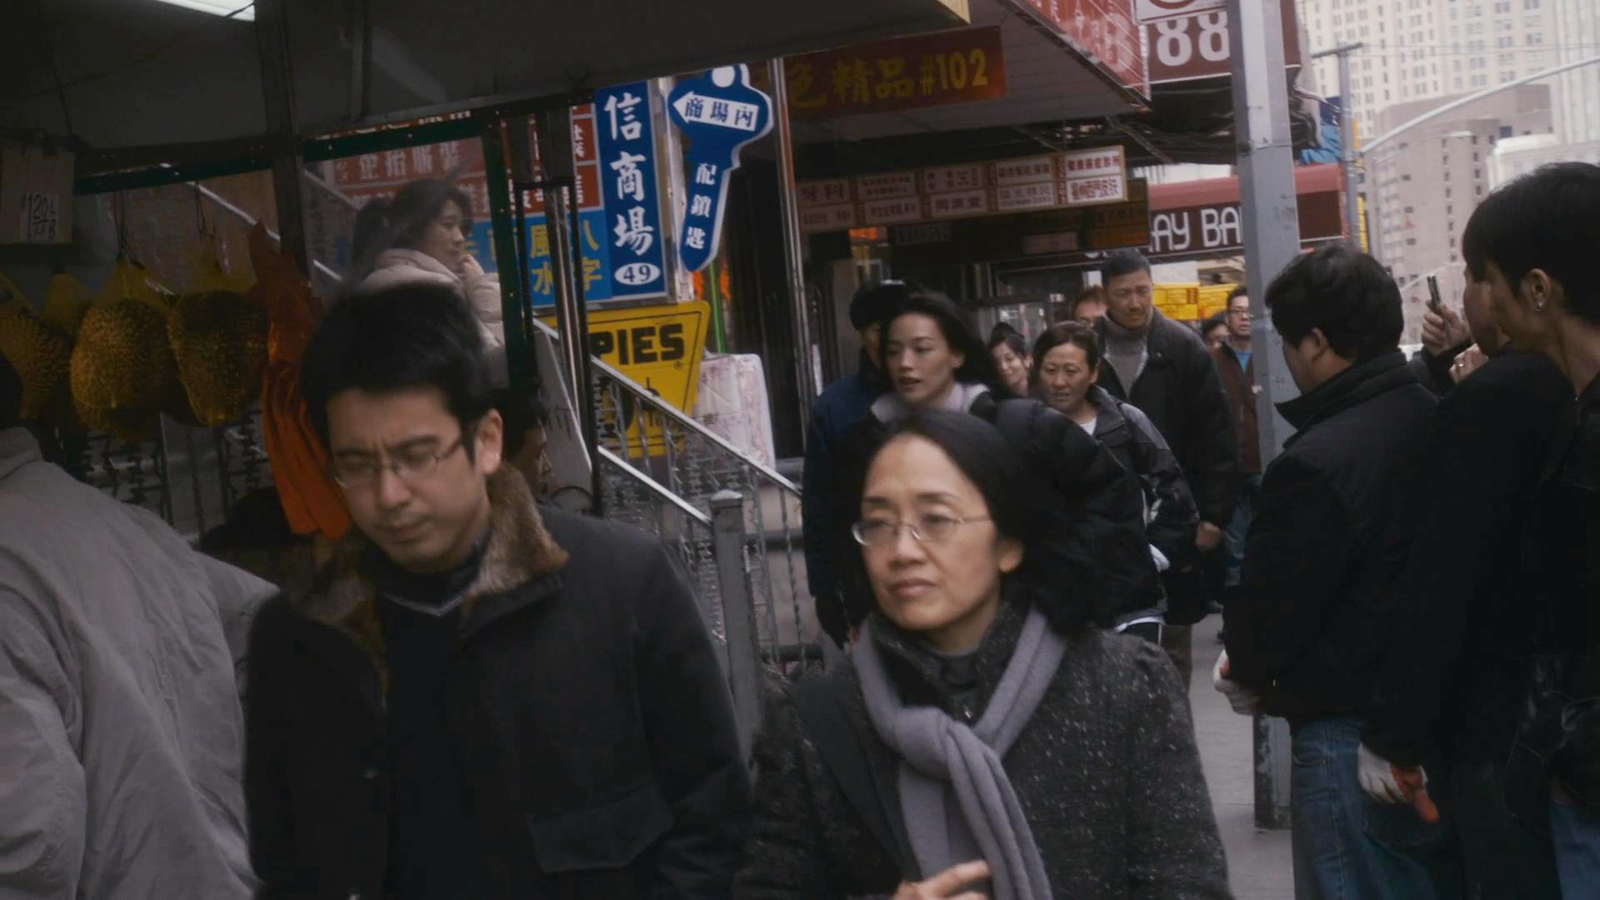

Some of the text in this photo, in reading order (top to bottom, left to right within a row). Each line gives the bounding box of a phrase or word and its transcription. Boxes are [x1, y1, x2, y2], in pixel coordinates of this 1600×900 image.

[921, 48, 989, 97] #102
[603, 91, 656, 257] 信商場
[685, 162, 718, 250] 配鎖匙
[1148, 205, 1242, 253] AY BA
[621, 264, 652, 285] 49
